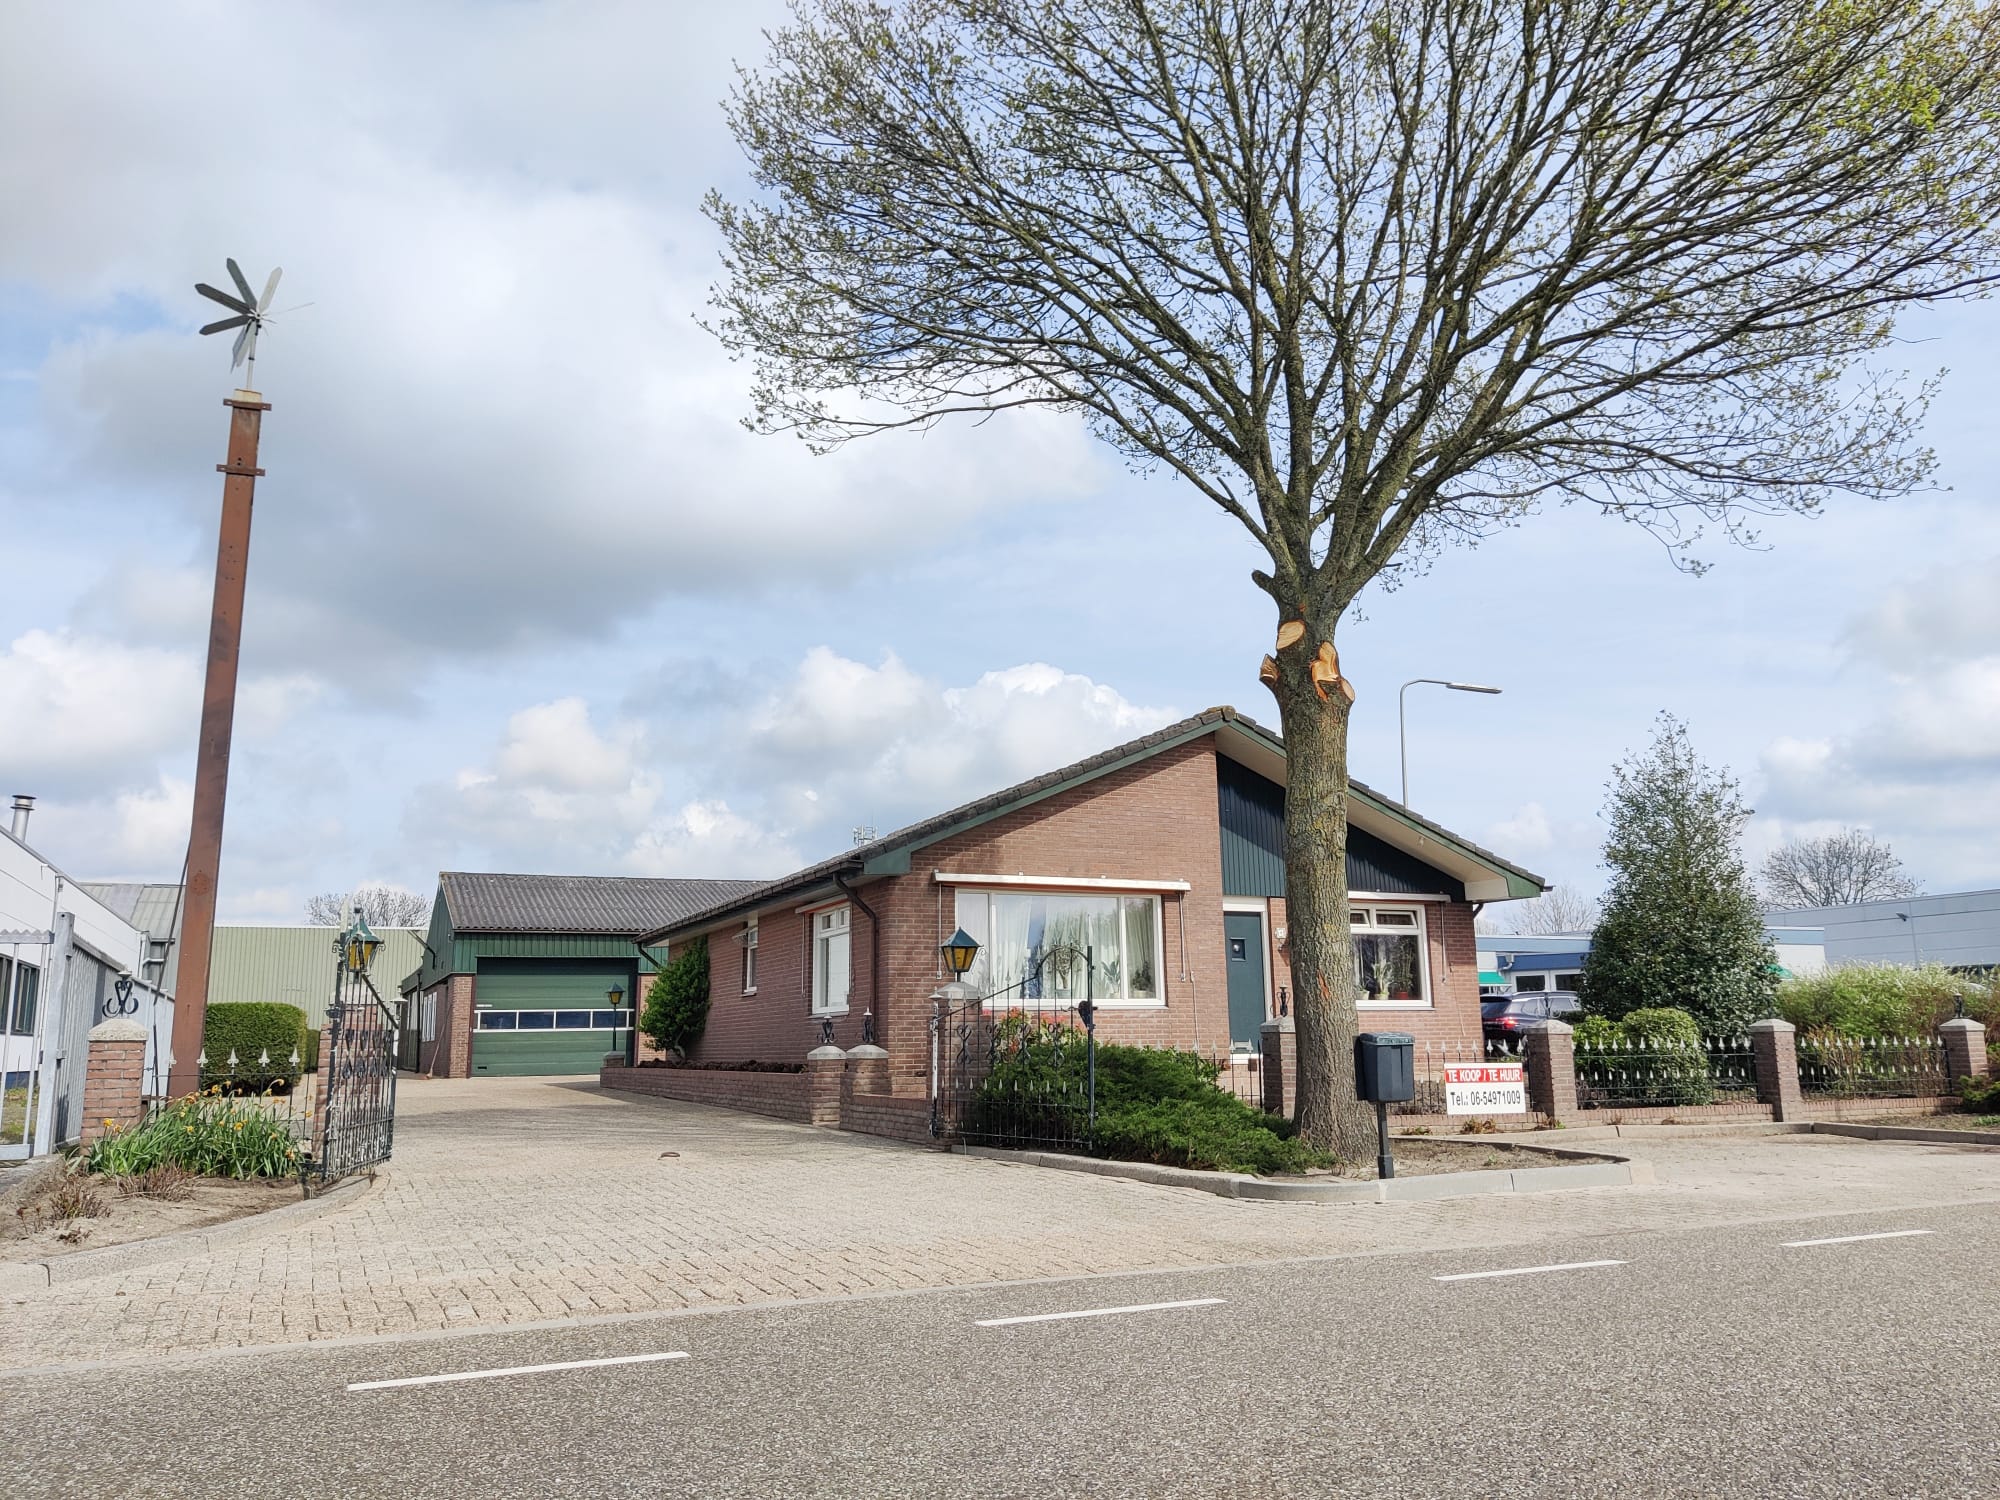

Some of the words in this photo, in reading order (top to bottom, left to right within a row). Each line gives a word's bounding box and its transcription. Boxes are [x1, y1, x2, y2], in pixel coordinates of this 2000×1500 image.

[1447, 1069, 1458, 1082] TE
[1460, 1069, 1481, 1081] KOOP
[1488, 1069, 1498, 1081] TE
[1500, 1069, 1521, 1081] HUUR
